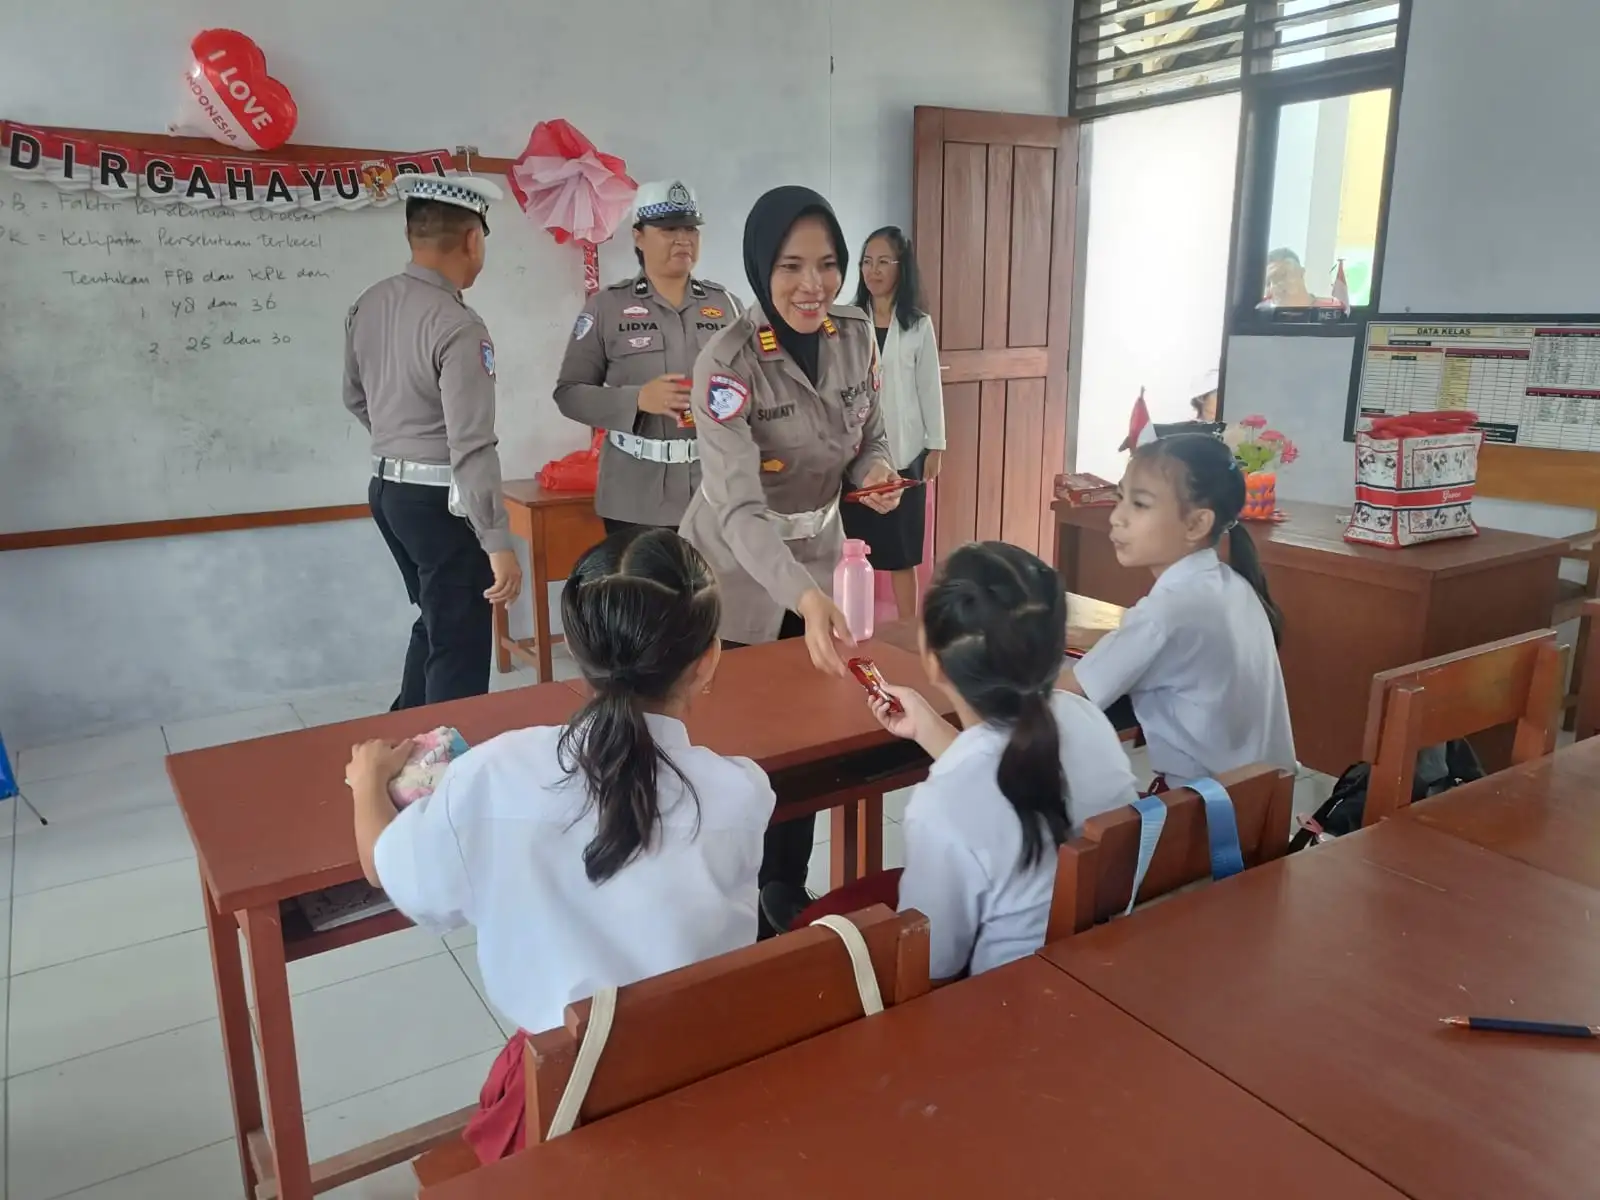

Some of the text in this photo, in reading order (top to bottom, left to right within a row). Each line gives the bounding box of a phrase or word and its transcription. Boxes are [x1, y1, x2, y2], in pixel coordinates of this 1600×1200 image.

[208, 49, 273, 131] I LOVE
[184, 71, 237, 141] INDONESIA
[9, 131, 360, 203] DIRGAHAYU
[57, 191, 121, 212] Faktor
[62, 270, 151, 286] Tentukan
[164, 268, 194, 287] FPB
[203, 271, 234, 283] dan
[171, 297, 195, 319] 48
[207, 297, 238, 310] dan
[251, 292, 277, 312] 36
[618, 322, 658, 332] LIDYA
[1441, 328, 1471, 336] KELAS
[185, 336, 212, 353] 25
[222, 331, 262, 346] dan
[271, 332, 292, 345] 30
